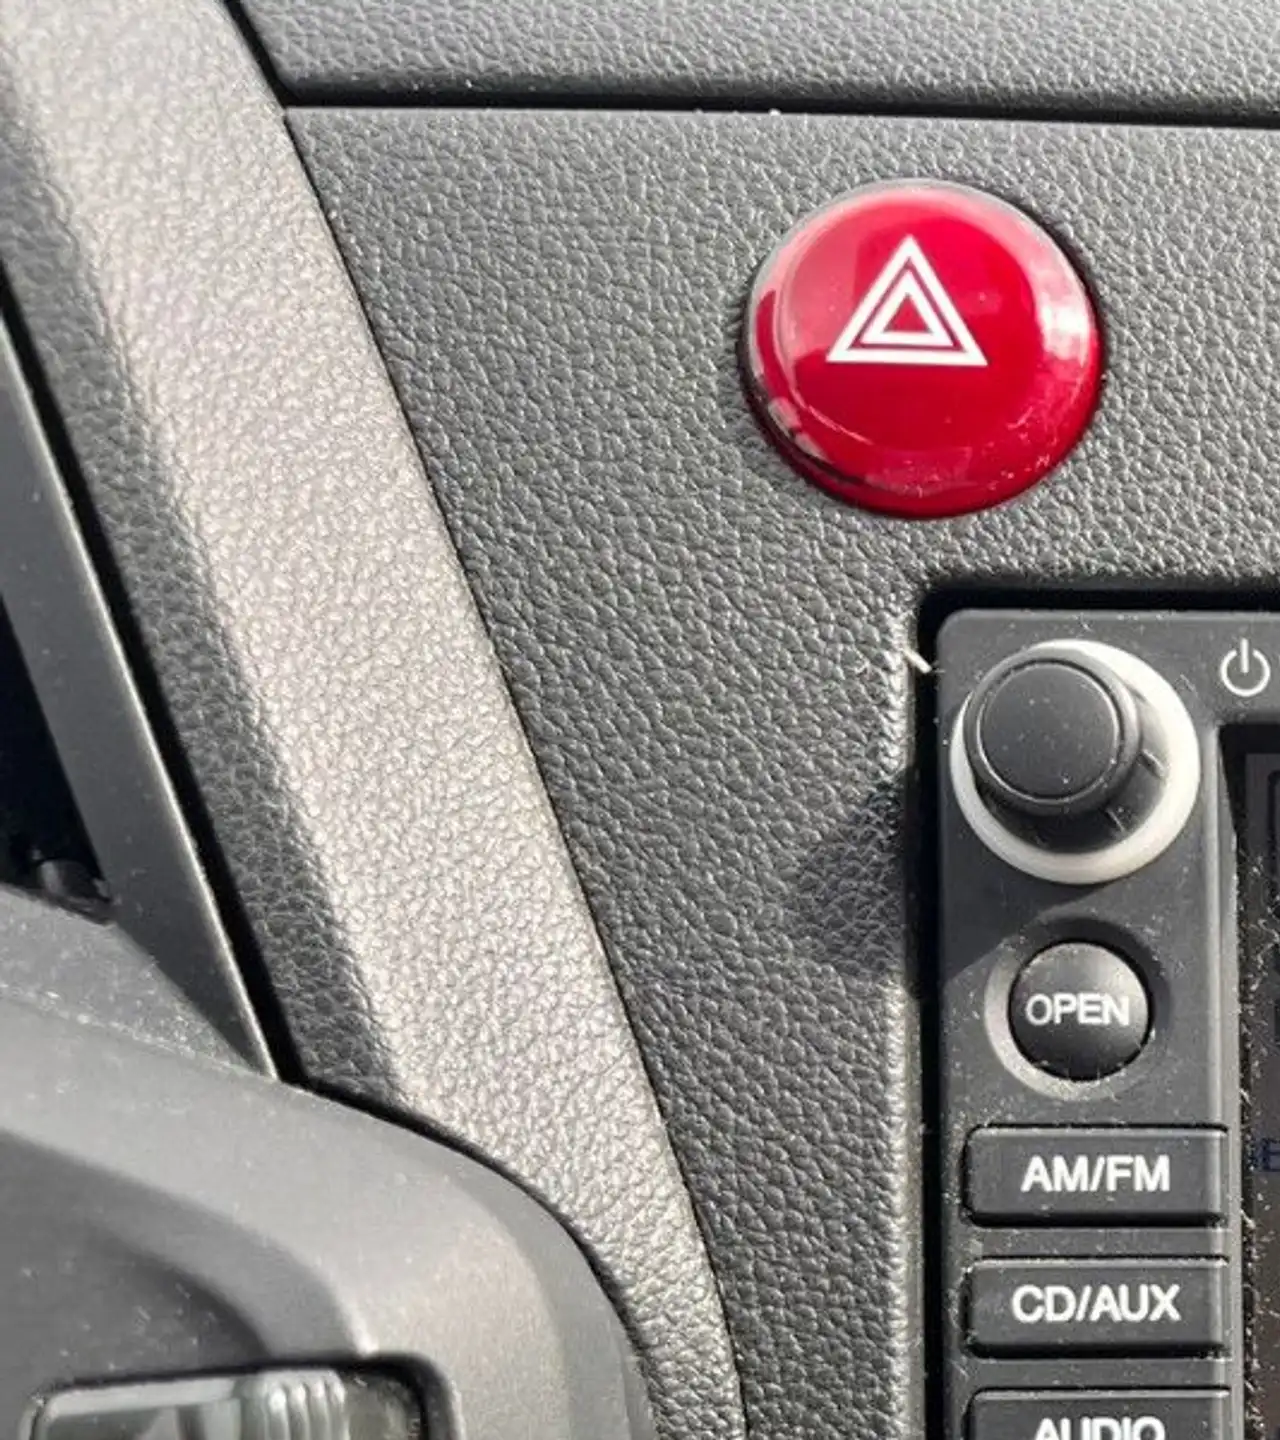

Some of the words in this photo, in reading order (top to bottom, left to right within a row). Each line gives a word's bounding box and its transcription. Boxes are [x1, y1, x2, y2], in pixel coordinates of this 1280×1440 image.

[1026, 993, 1130, 1026] OPEN
[1021, 1155, 1170, 1192] AM/FM
[1012, 1285, 1180, 1323] CD/AUX
